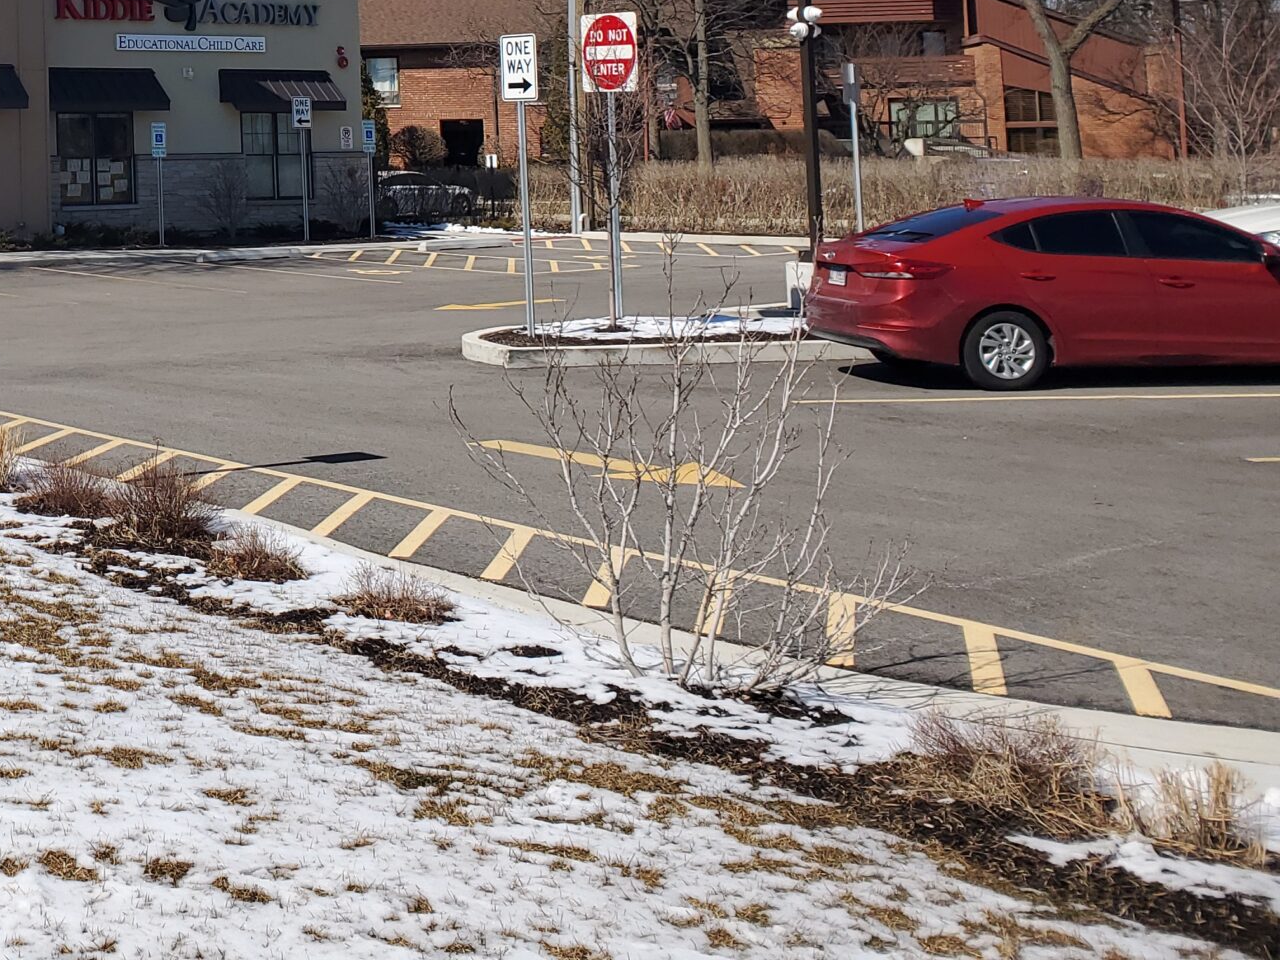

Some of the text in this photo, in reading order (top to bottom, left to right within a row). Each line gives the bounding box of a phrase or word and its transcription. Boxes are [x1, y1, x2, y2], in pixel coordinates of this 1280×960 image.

[589, 29, 628, 42] DO NOT
[119, 36, 264, 50] EDUCATIONAL CHILD CARE
[506, 41, 531, 55] ONE
[507, 59, 532, 75] WAY
[594, 63, 625, 76] ENTER
[294, 99, 309, 107] ONE
[295, 108, 309, 116] WAY
